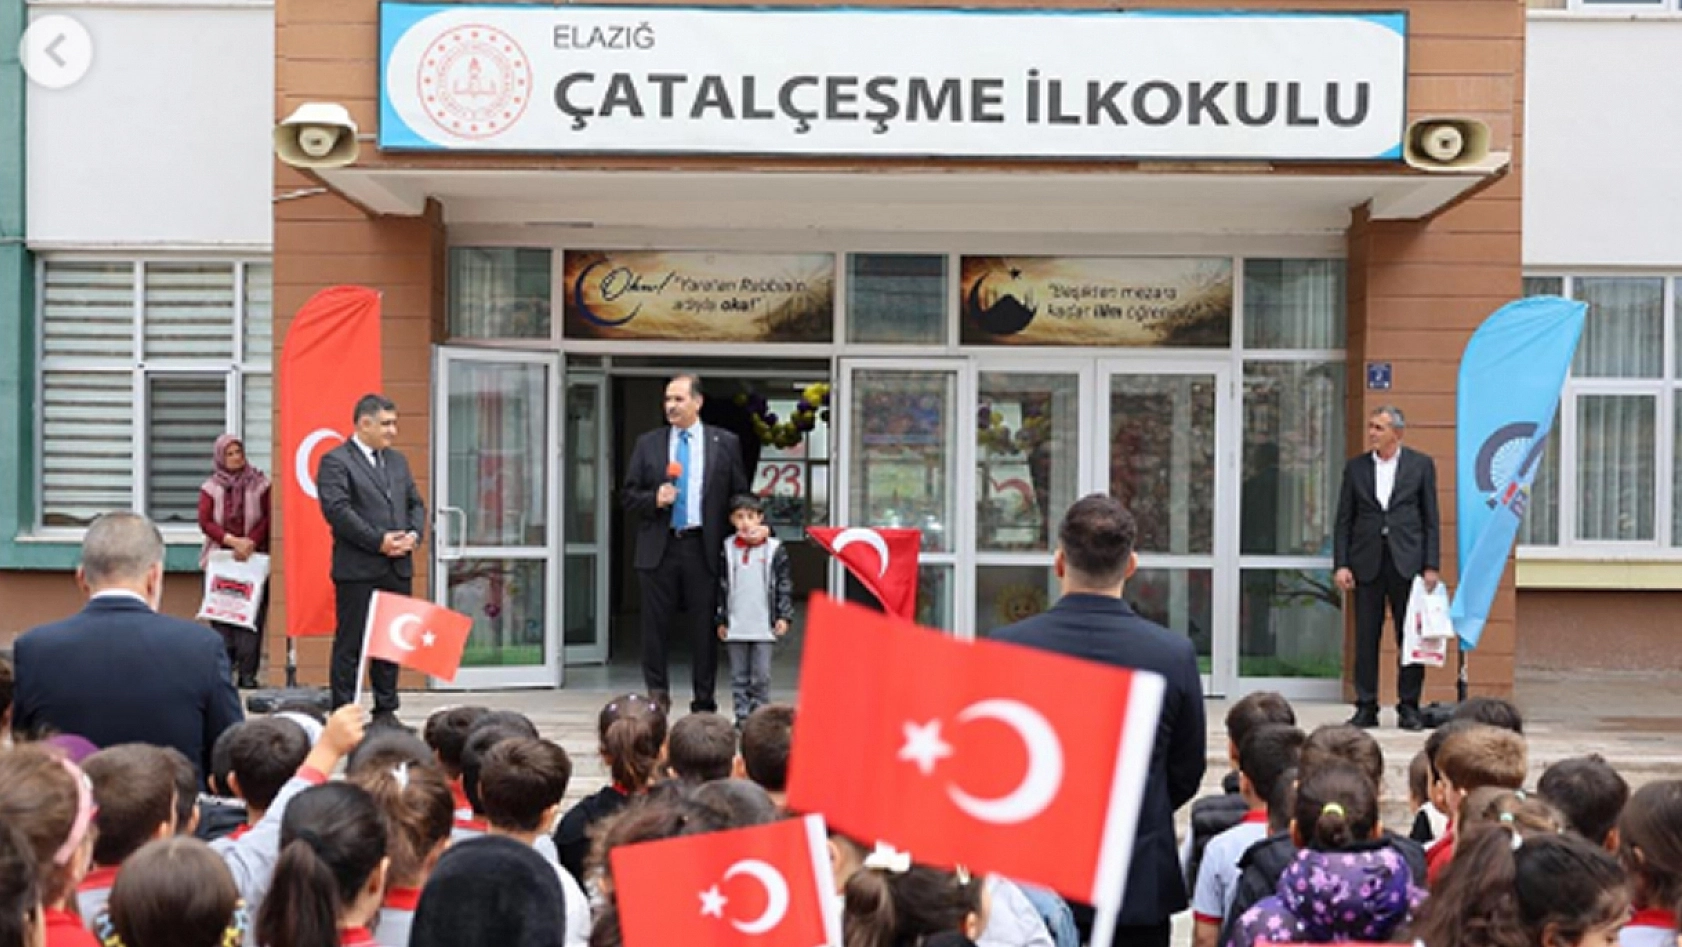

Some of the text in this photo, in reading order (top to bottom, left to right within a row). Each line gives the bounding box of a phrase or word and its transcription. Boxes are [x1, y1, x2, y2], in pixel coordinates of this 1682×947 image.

[553, 21, 656, 50] ELAZIĞ
[553, 71, 1005, 135] ÇATALÇEŞME
[1026, 68, 1371, 127] İLKOKULU
